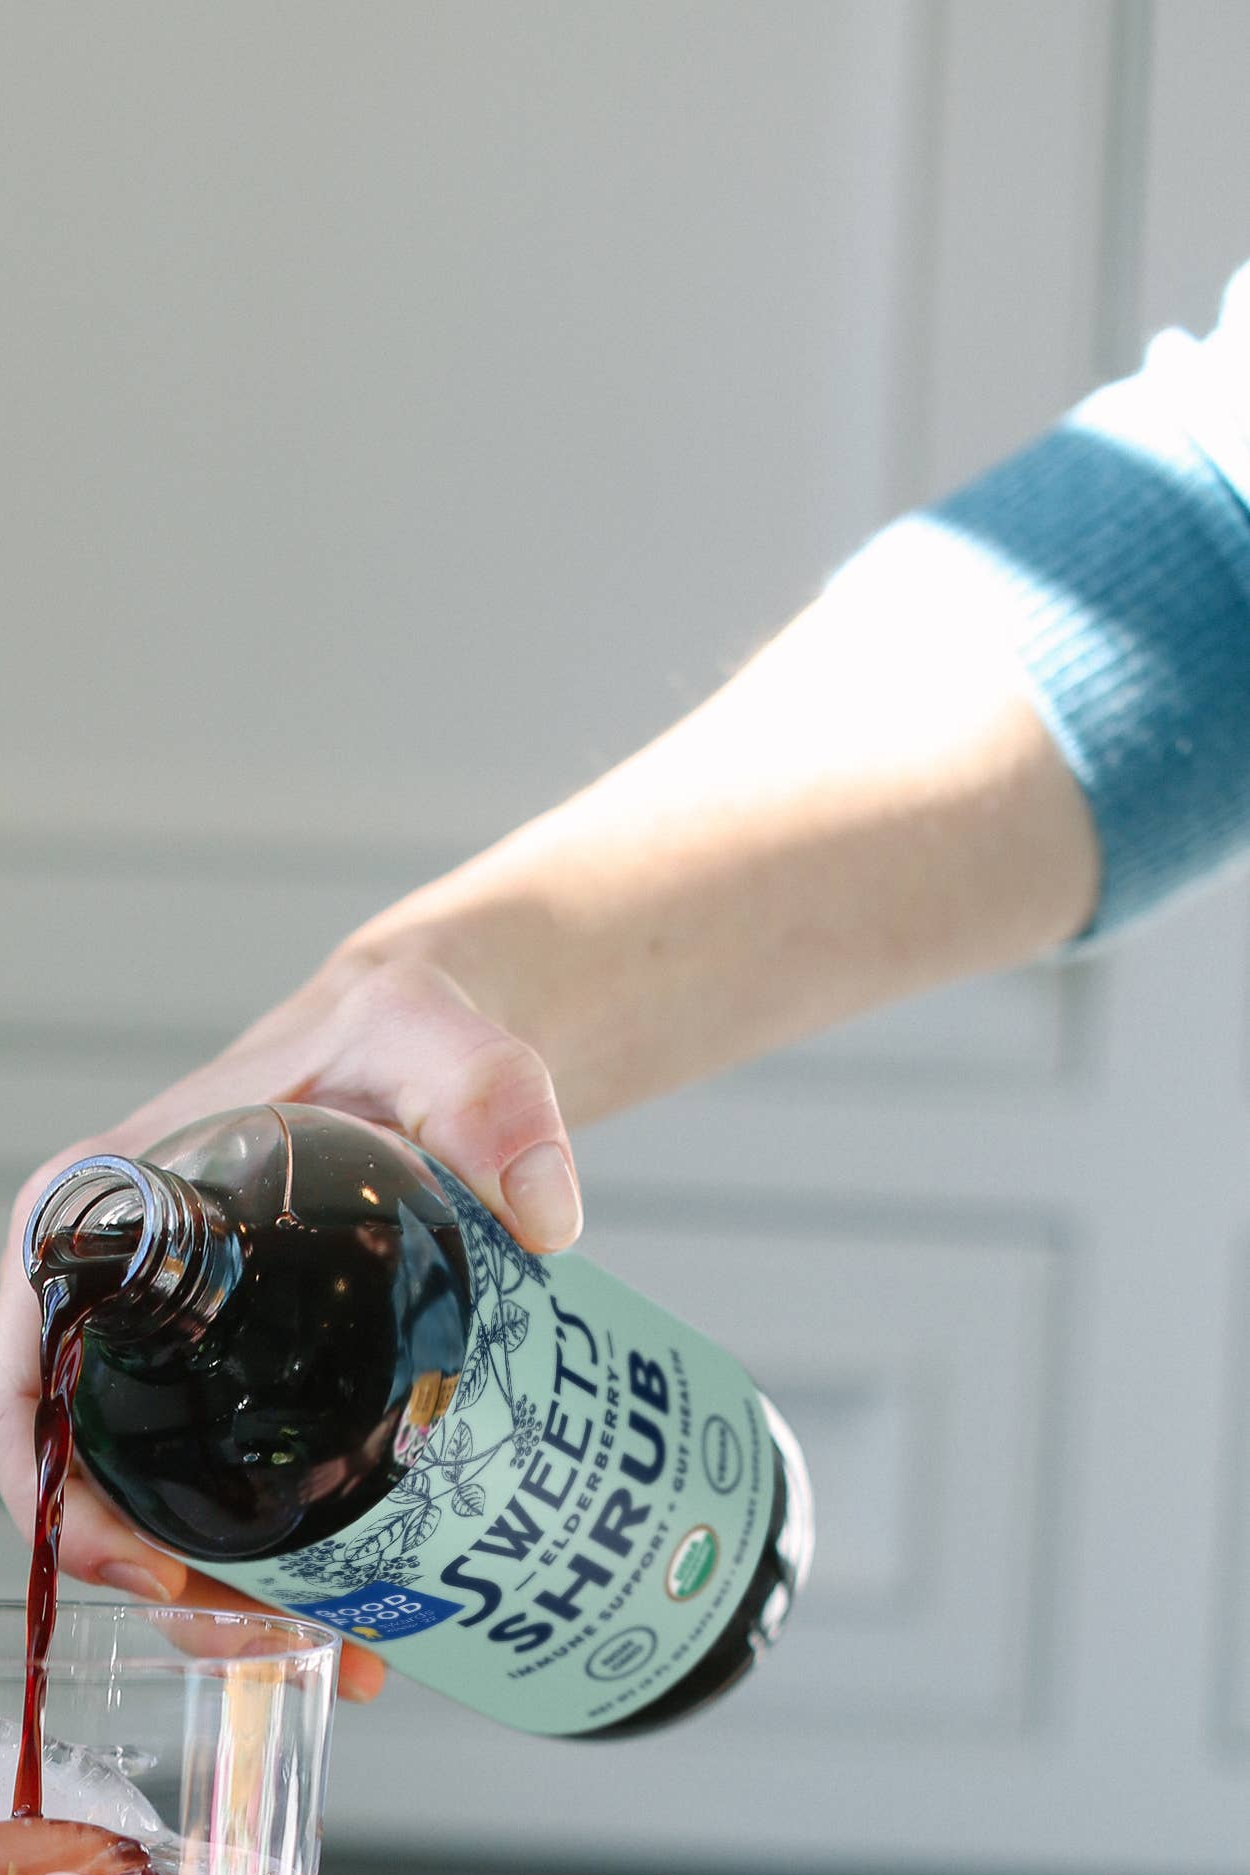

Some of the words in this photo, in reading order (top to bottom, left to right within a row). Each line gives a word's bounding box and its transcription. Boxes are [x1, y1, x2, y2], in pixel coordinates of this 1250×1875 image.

[669, 1347, 691, 1437] HEALTH
[440, 1295, 598, 1628] SWEET'S
[488, 1349, 670, 1654] SHRUB
[539, 1366, 620, 1566] ELDERBERRY
[672, 1443, 689, 1492] GUT
[314, 1594, 408, 1619] GOOD
[328, 1602, 422, 1626] FOOD
[598, 1520, 670, 1622] SUPPORT
[507, 1624, 598, 1680] IMMUNE
